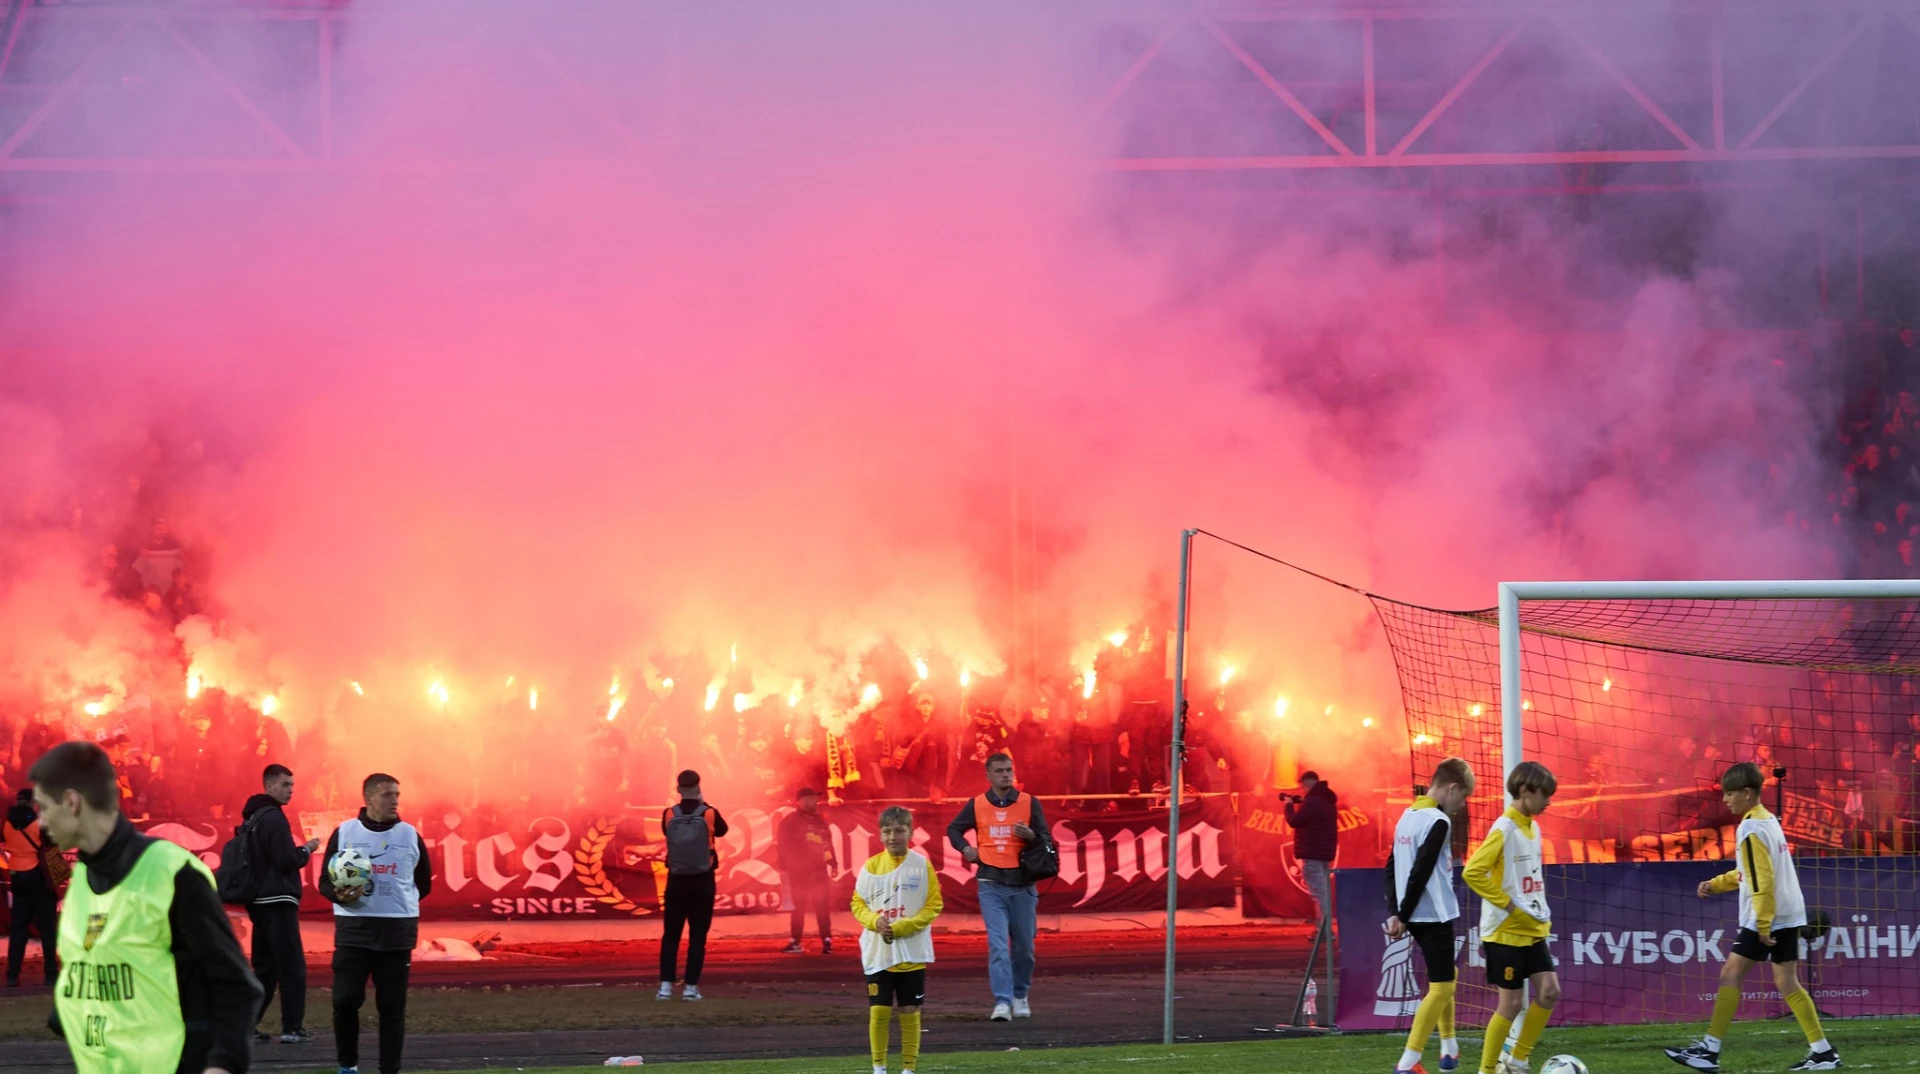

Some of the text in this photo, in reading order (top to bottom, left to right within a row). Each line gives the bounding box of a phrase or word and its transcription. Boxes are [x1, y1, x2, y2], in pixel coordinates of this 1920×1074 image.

[492, 898, 597, 914] SINCE
[1572, 929, 1728, 966] КУБОК
[1504, 966, 1514, 981] 8
[868, 983, 879, 996] 10
